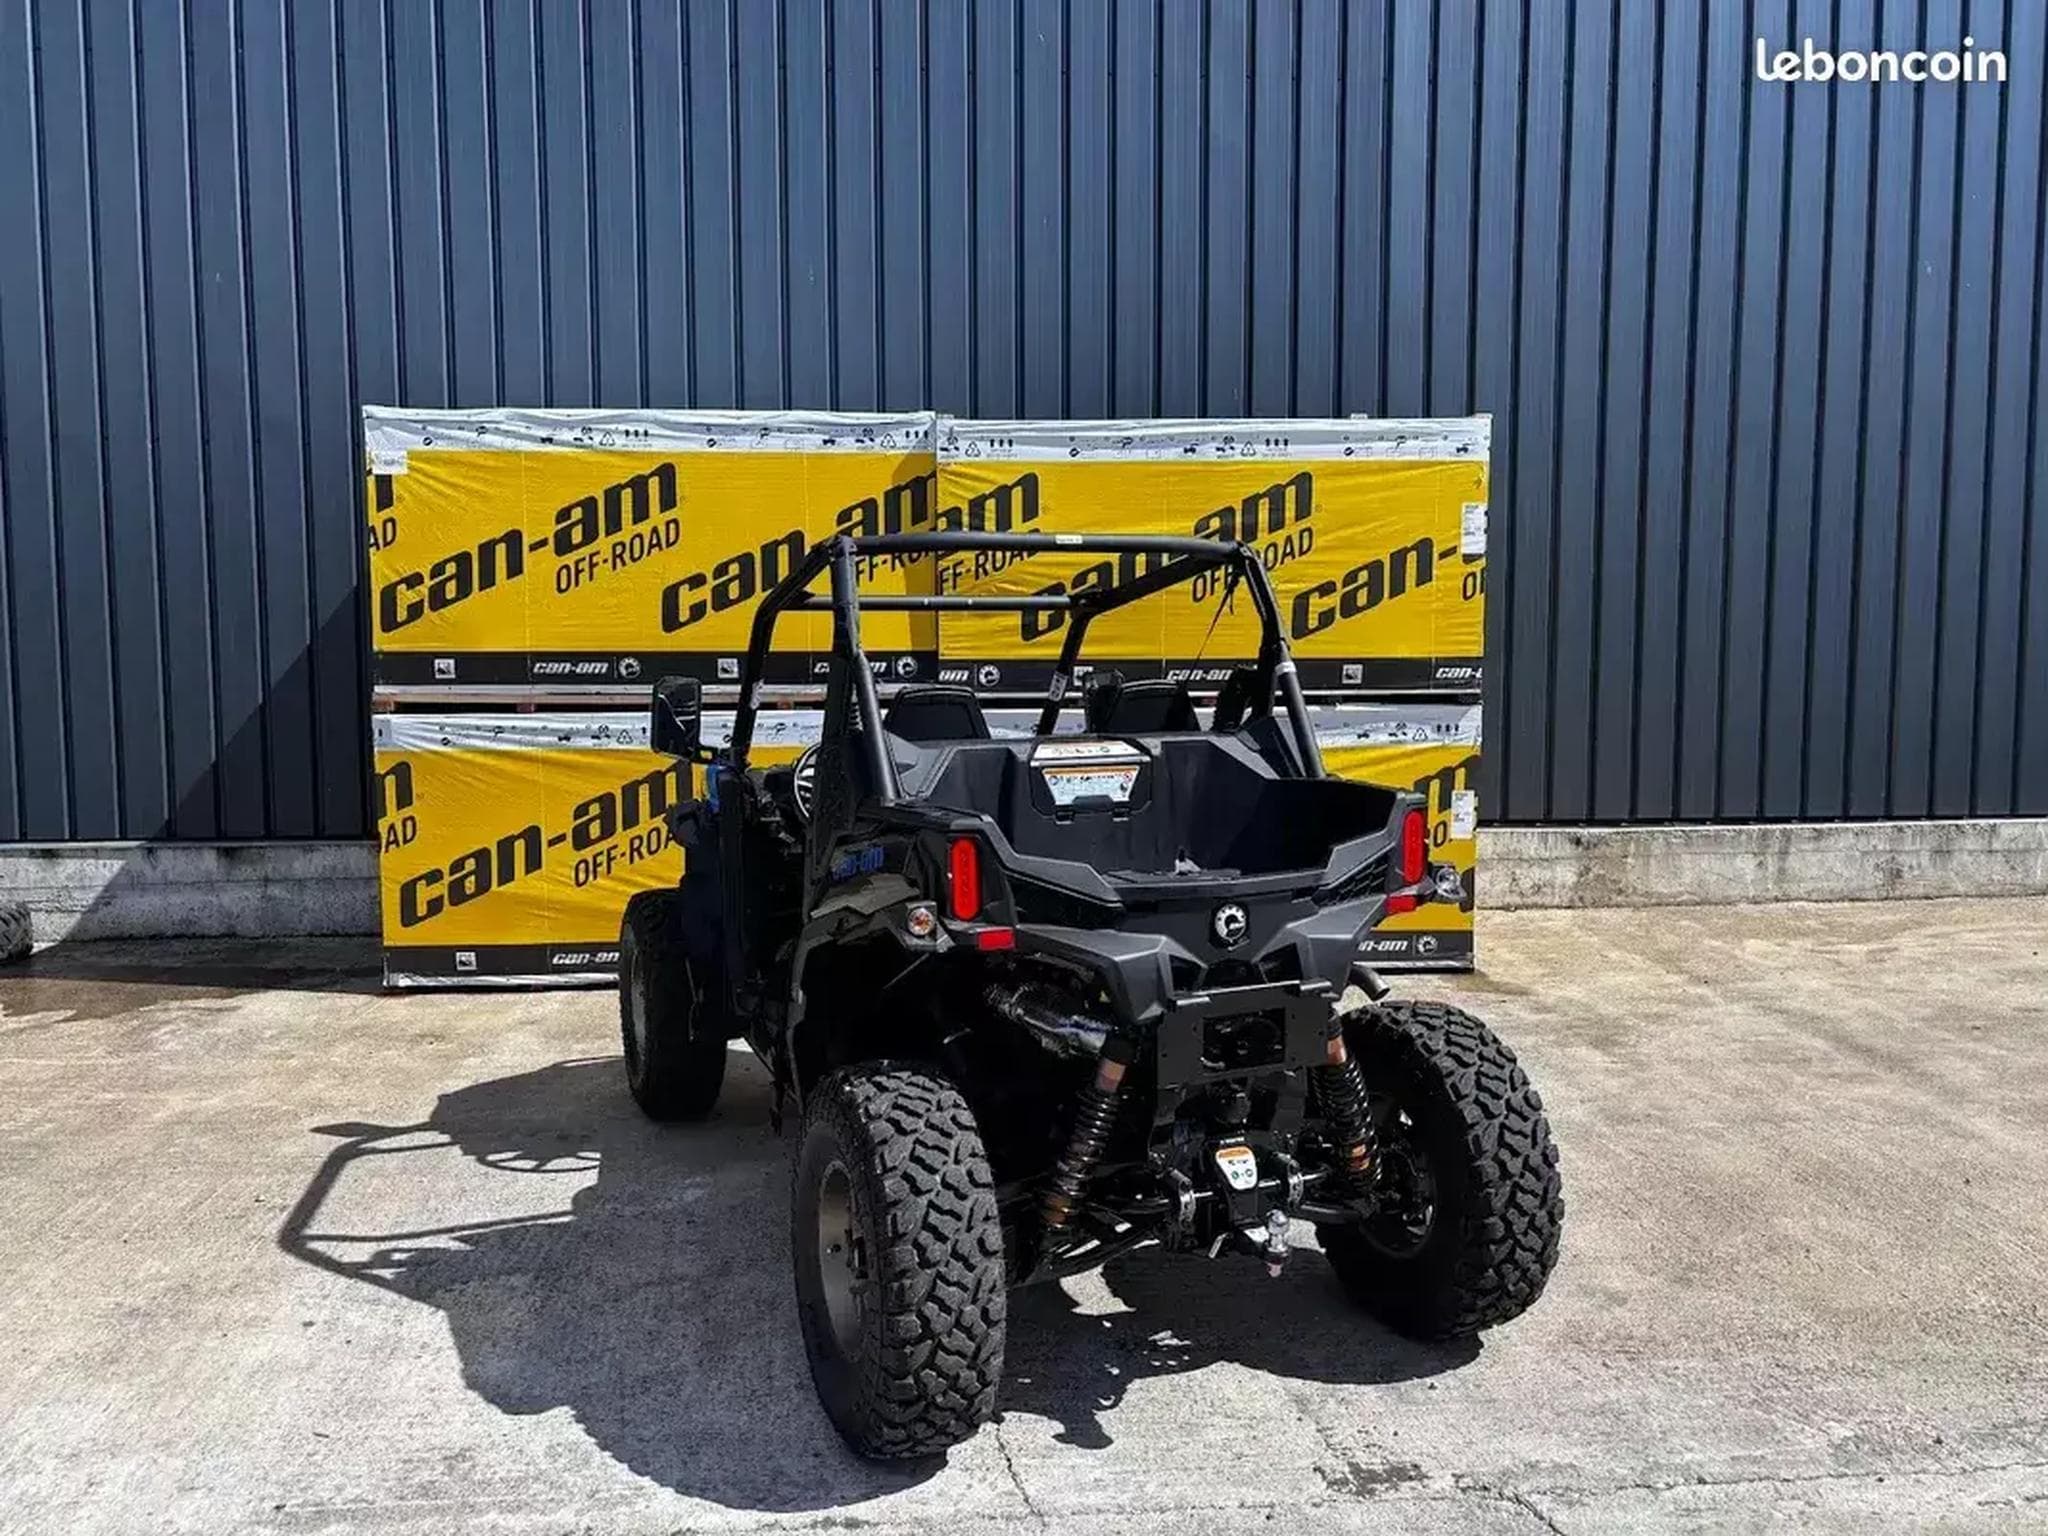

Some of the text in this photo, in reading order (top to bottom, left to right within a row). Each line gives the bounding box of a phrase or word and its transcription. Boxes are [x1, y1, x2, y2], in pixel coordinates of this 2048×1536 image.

[380, 462, 677, 633] can-am
[556, 518, 680, 594] OFF-ROAD
[533, 662, 608, 674] can-am
[400, 760, 692, 928] can-am
[575, 827, 671, 888] OFF-RO
